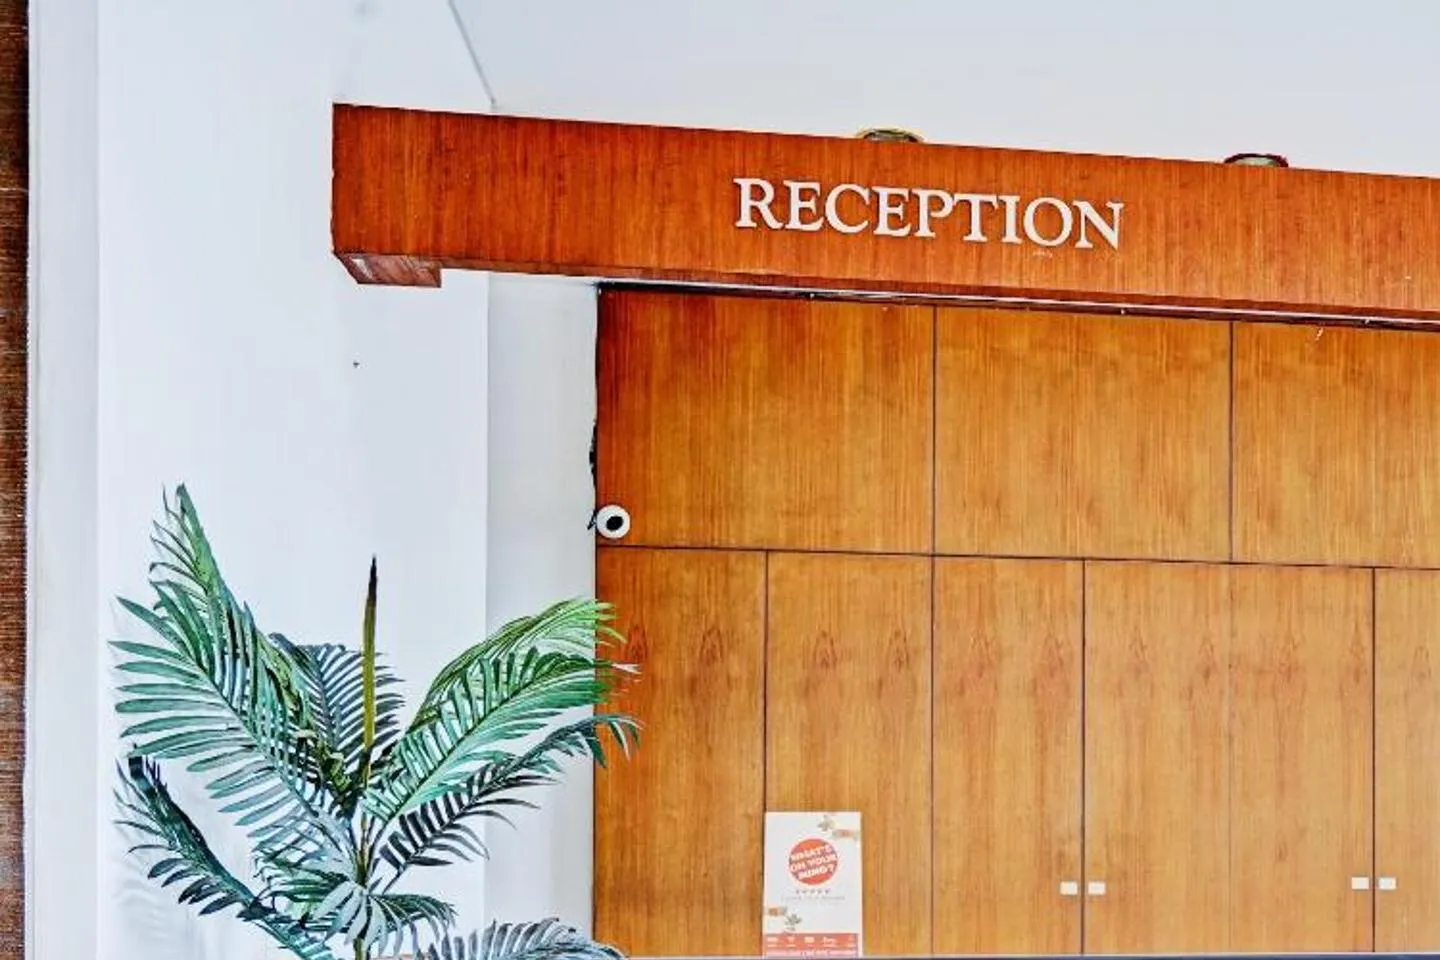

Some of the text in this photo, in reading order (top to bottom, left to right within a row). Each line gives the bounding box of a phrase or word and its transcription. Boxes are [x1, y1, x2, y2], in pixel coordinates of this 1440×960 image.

[733, 177, 1126, 251] RECEPTION
[790, 853, 837, 873] ON YOUR
